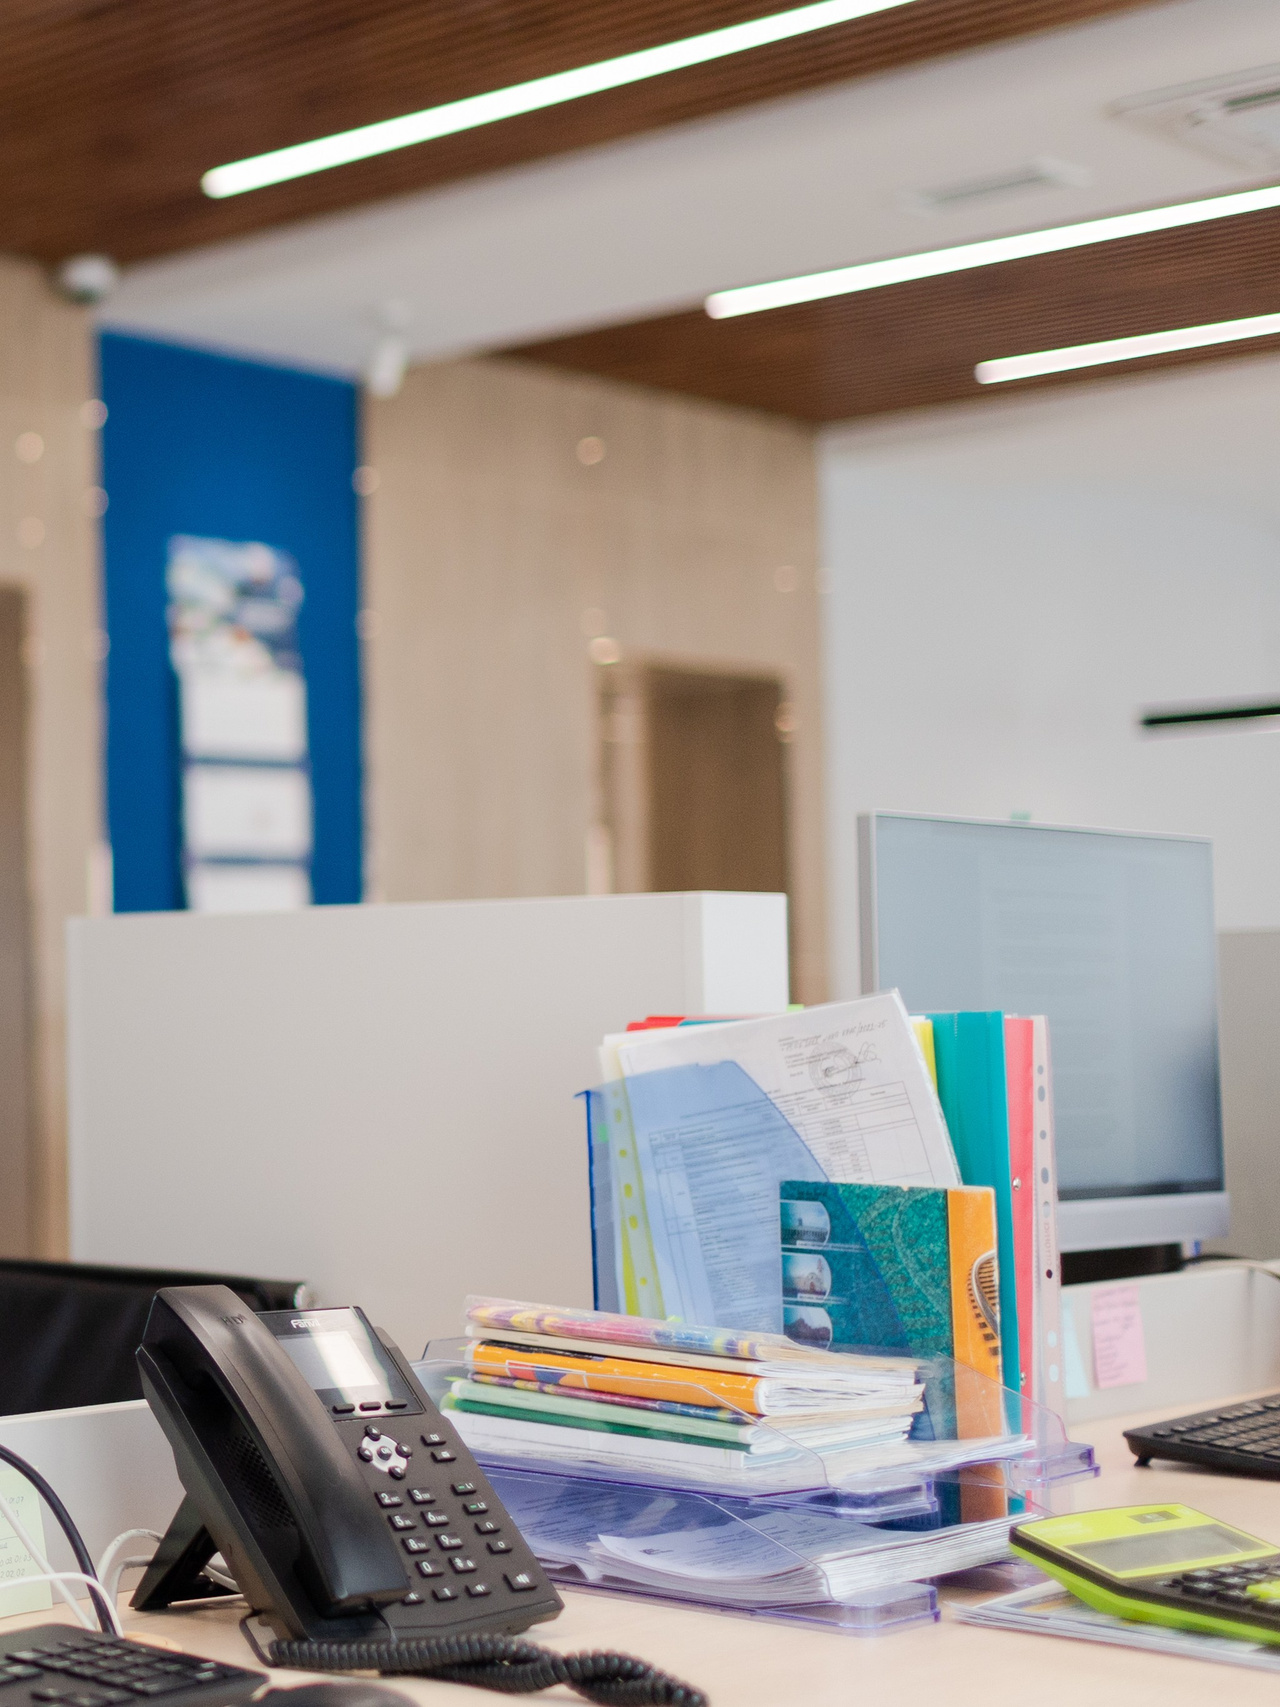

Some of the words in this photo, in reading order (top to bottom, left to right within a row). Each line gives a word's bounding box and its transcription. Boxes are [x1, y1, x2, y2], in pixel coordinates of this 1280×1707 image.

[290, 1318, 320, 1328] Fanvil
[381, 1493, 391, 1503] 2
[413, 1490, 422, 1499] 3
[394, 1516, 404, 1526] 5
[428, 1512, 436, 1521] 6
[409, 1539, 418, 1549] 8
[441, 1535, 449, 1545] 9
[422, 1562, 432, 1573] 0
